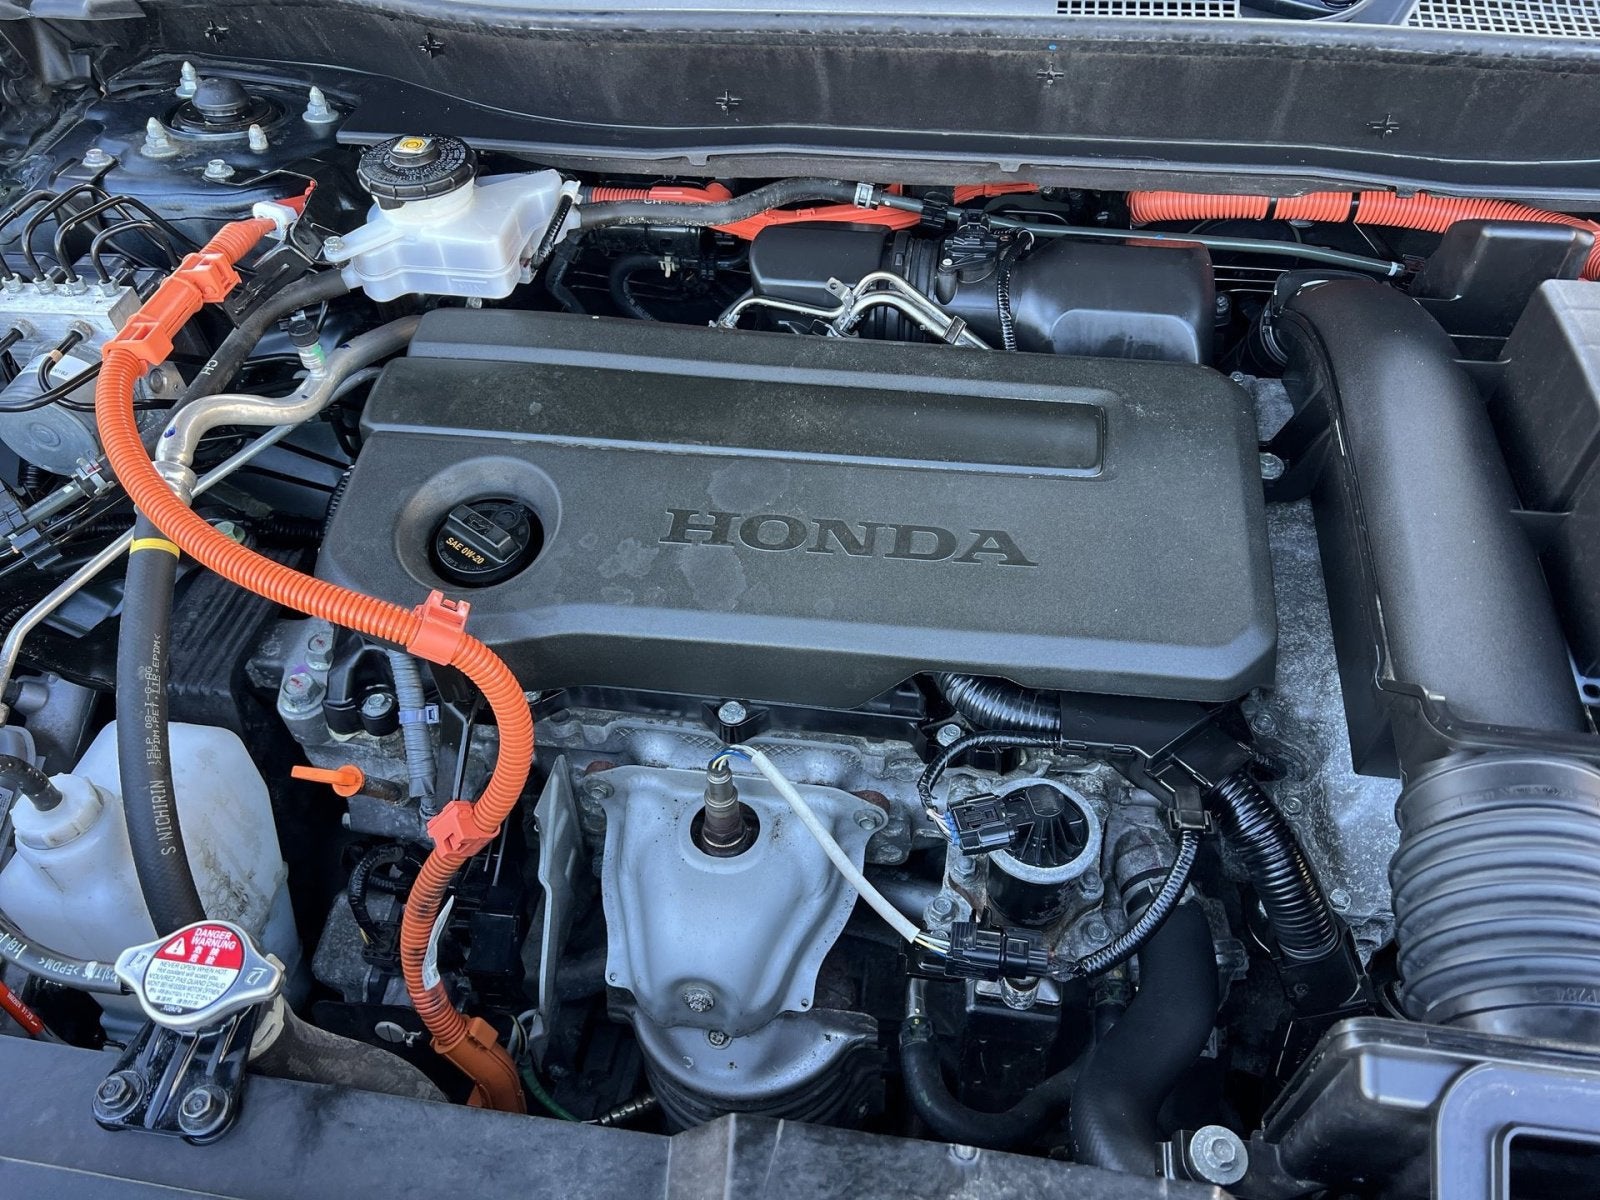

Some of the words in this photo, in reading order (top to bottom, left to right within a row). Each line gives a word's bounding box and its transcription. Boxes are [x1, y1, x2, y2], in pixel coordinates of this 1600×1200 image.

[658, 508, 1039, 568] HONDA
[445, 537, 464, 551] SAE
[460, 547, 485, 565] 0W-20
[194, 927, 232, 941] DANGER
[191, 935, 237, 950] WARNUNG
[159, 961, 179, 969] NEVER
[179, 963, 196, 971] OPEN
[196, 965, 214, 973] WHEN
